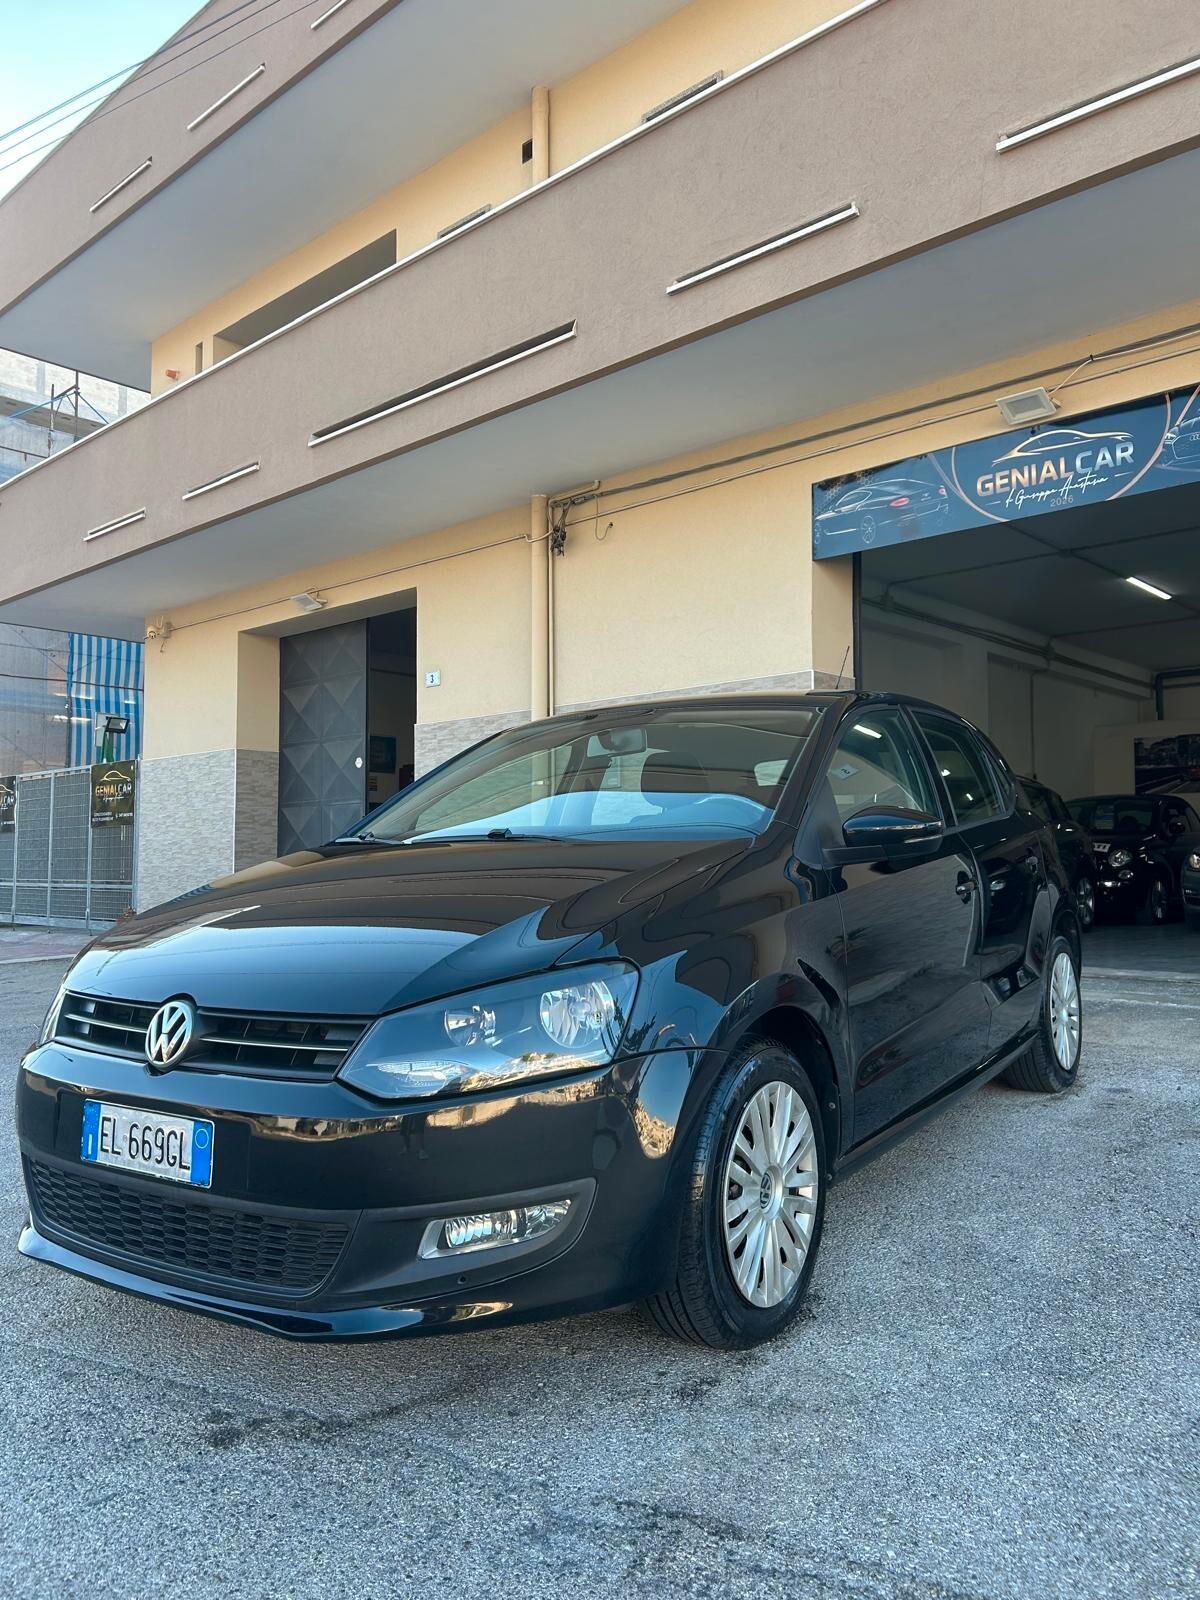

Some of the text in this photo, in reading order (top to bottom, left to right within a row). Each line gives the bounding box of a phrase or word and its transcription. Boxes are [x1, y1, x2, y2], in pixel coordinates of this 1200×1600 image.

[976, 441, 1135, 497] GENIALCAR
[95, 783, 132, 797] GENIALCAR
[100, 1116, 122, 1156] EL
[128, 1122, 191, 1170] 669GL
